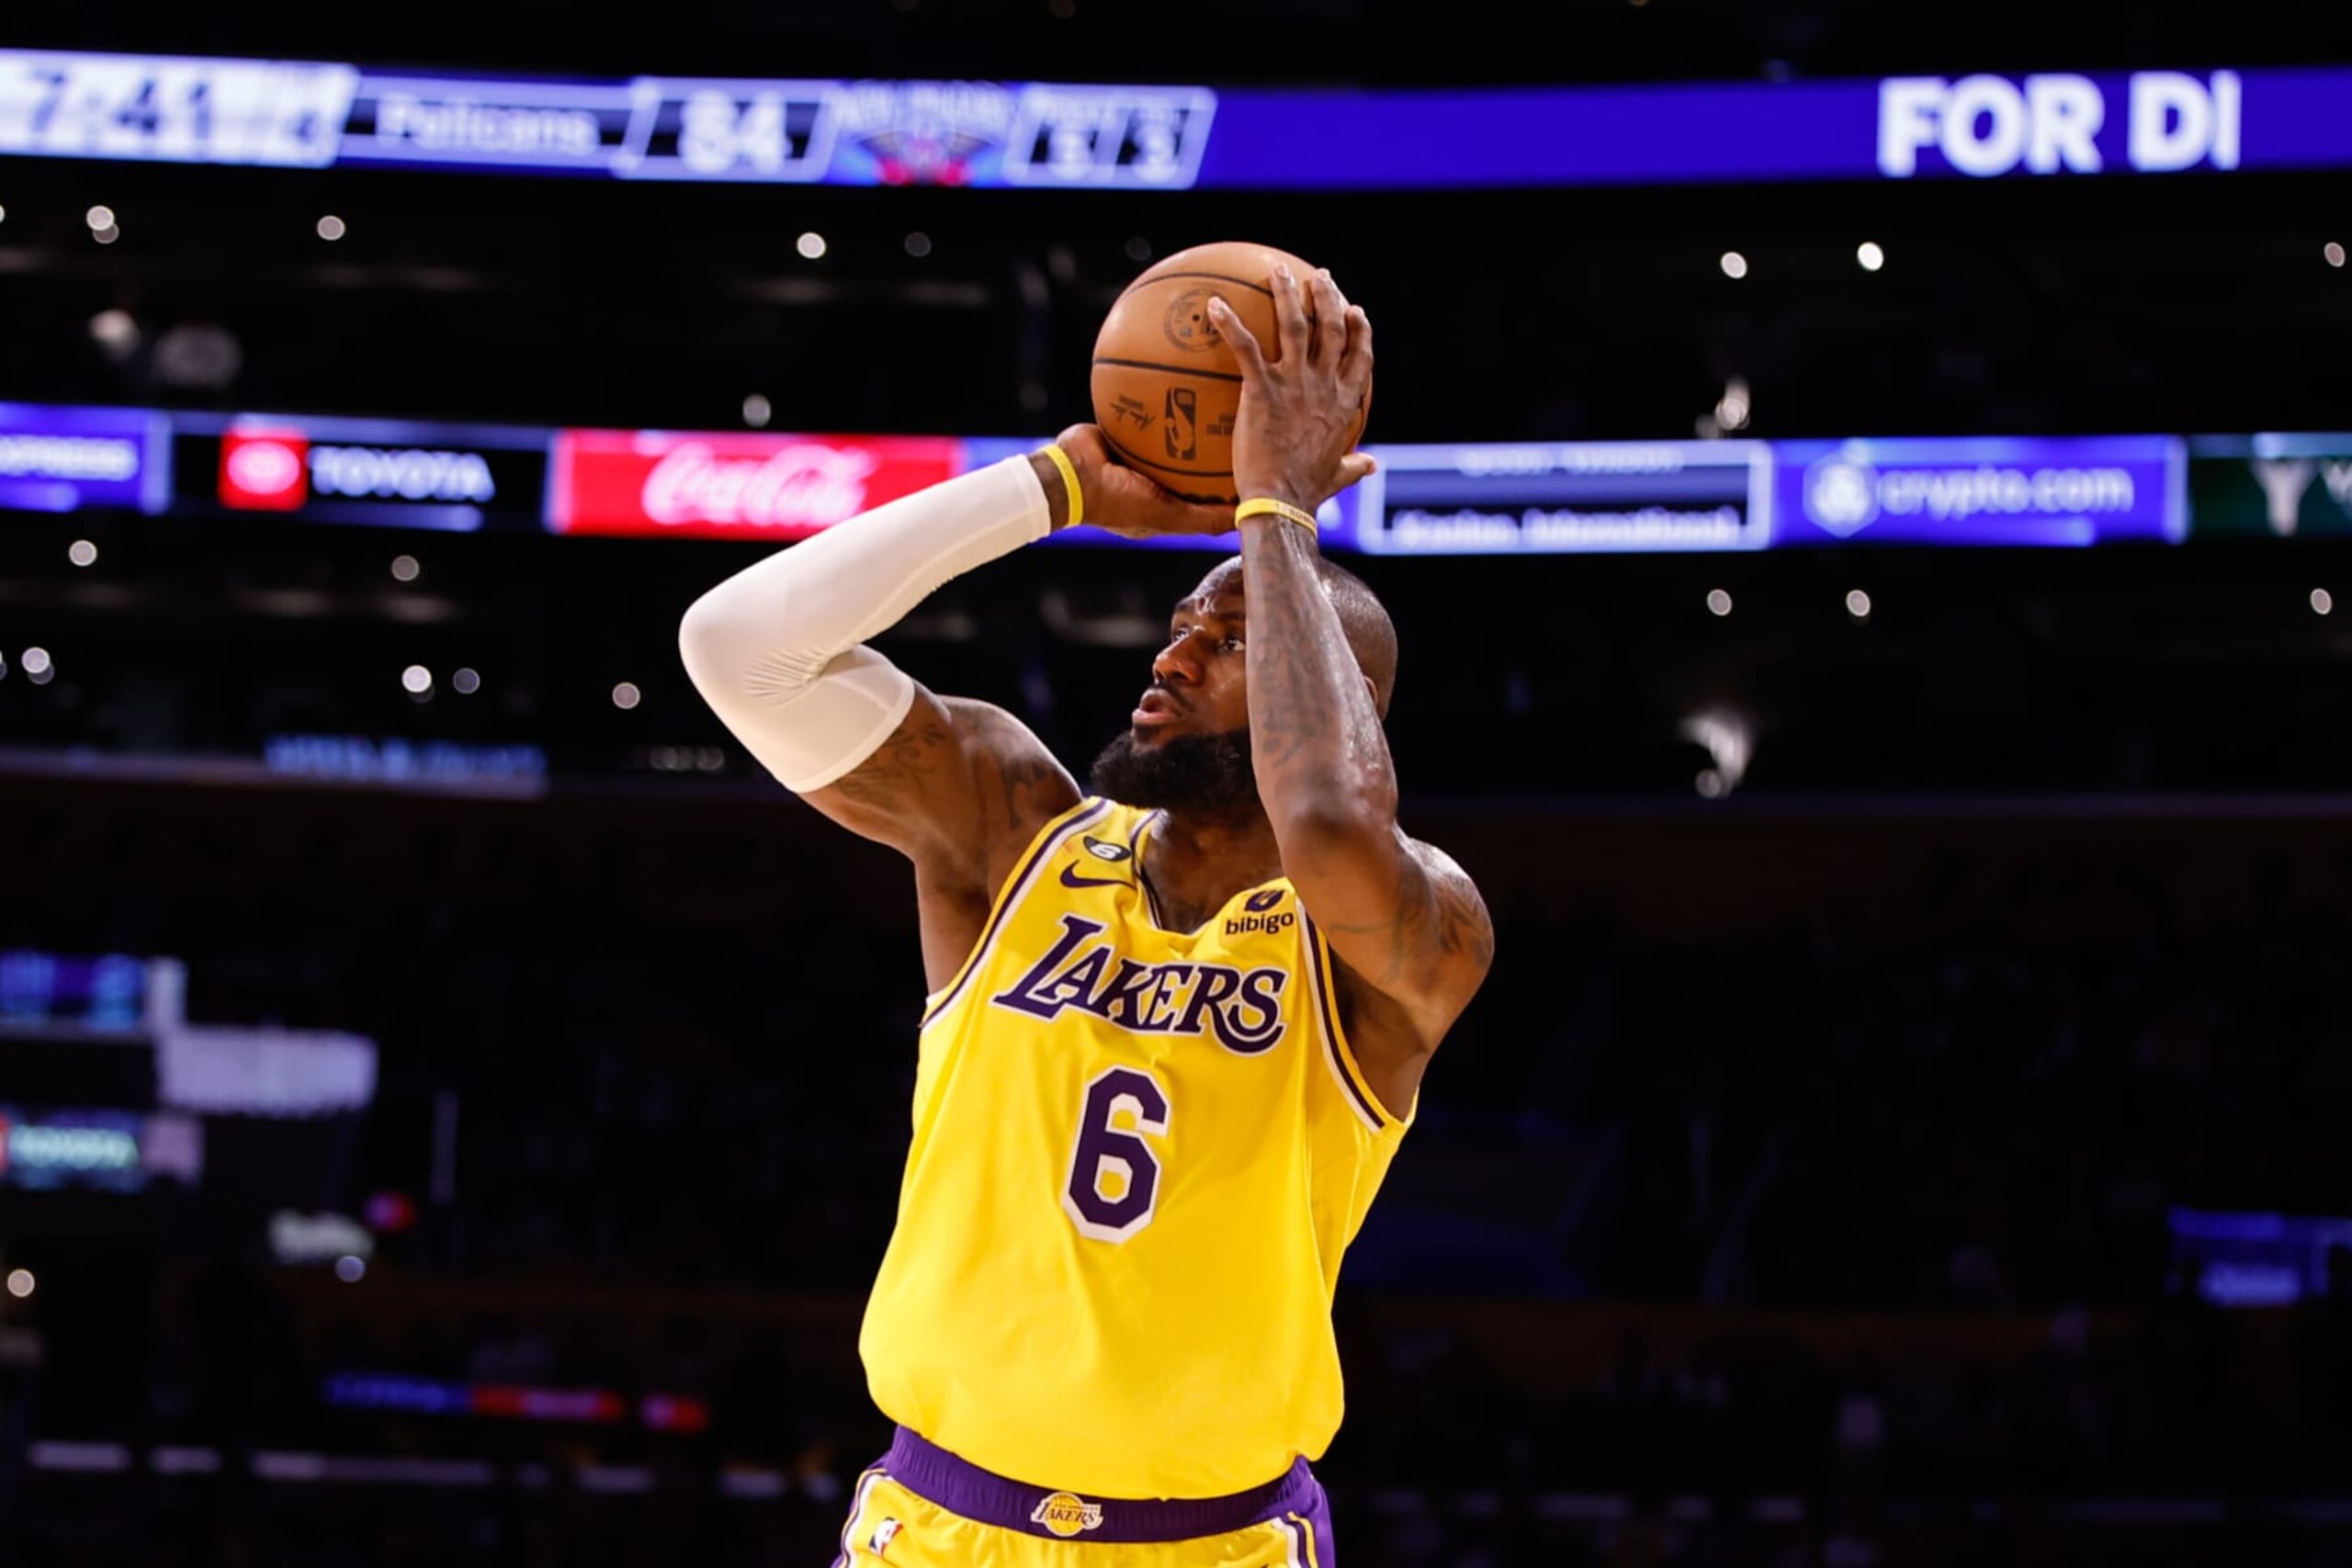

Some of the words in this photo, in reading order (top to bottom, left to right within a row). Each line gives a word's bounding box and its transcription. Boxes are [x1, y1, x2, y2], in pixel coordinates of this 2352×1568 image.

[375, 94, 603, 156] Pelicans
[678, 89, 792, 175] 84
[1876, 72, 2106, 178] FOR
[2127, 69, 2243, 173] DI
[309, 446, 496, 502] TOYOTA
[1877, 463, 2135, 521] crypto.com
[1226, 912, 1295, 935] bibigo
[991, 914, 1289, 1055] LAKERS
[1062, 1064, 1170, 1244] 6
[1035, 1499, 1102, 1529] LAKERS
